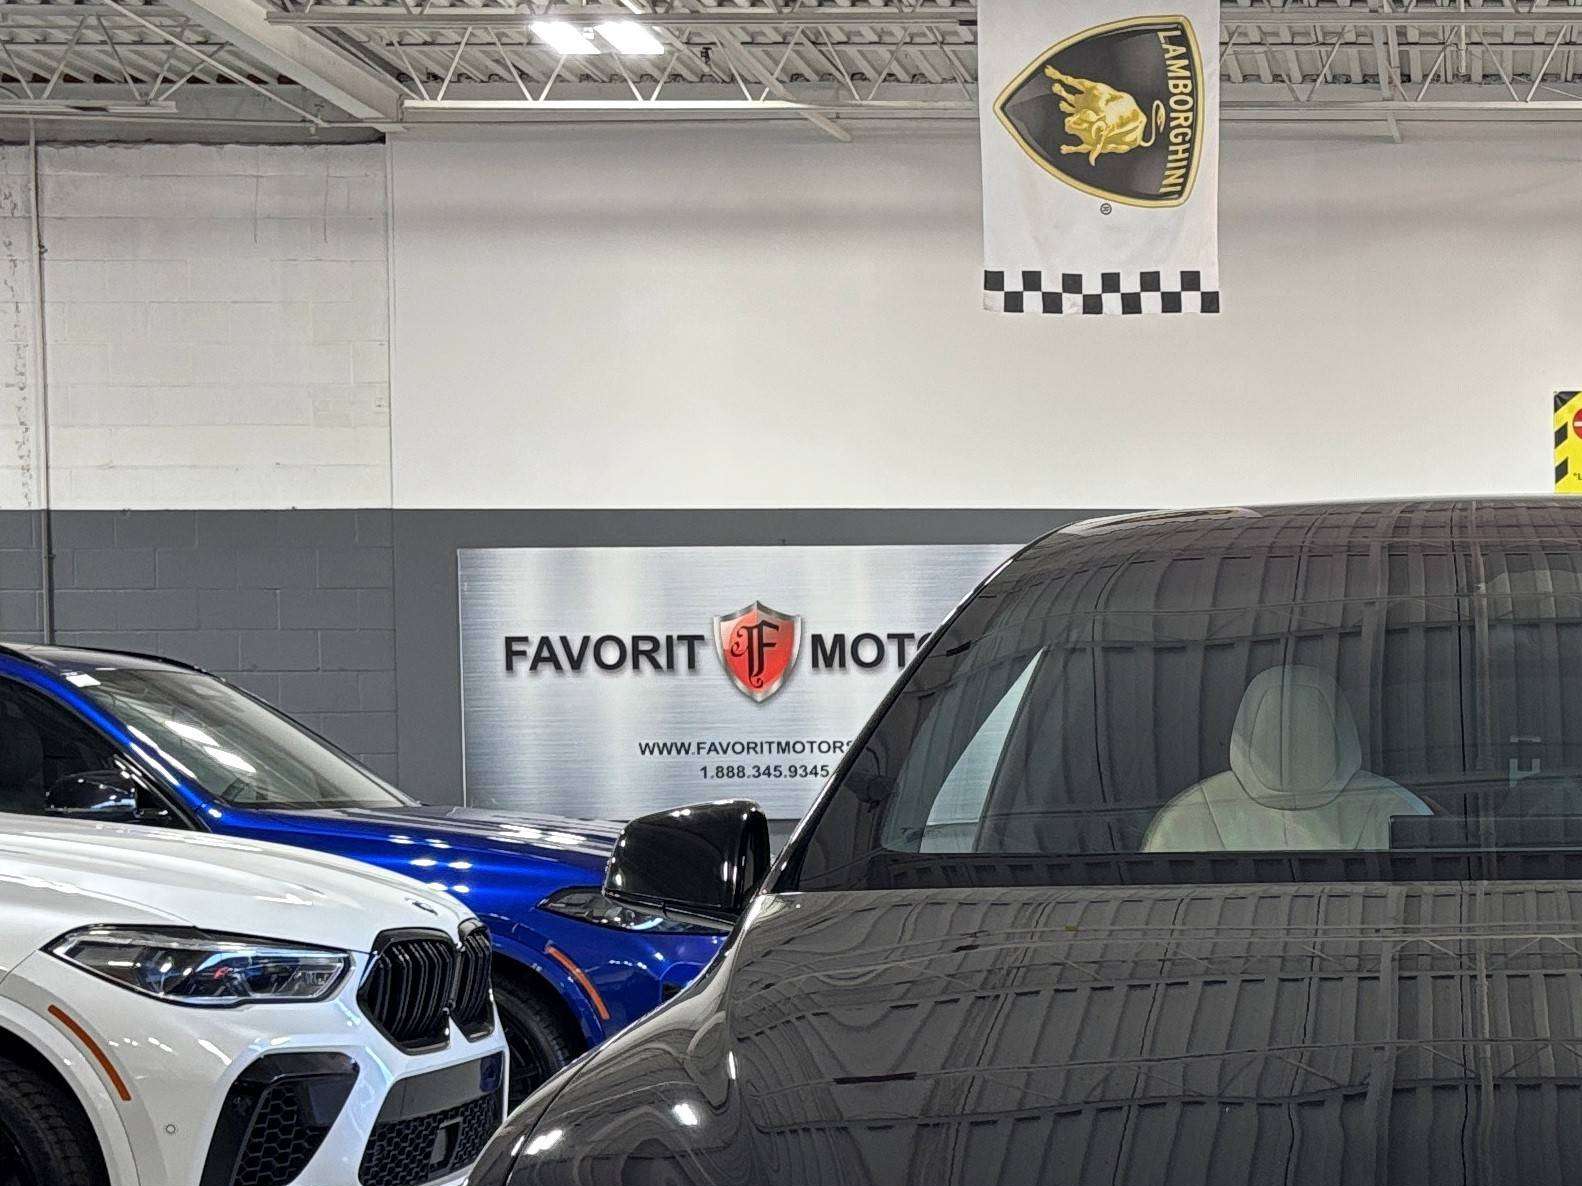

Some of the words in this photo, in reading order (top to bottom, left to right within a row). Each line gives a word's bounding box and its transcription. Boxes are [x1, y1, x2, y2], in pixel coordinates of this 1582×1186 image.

[1156, 29, 1193, 198] LAMBORGHINI
[504, 634, 704, 672] FAVORIT
[811, 632, 933, 668] MOT
[699, 764, 830, 779] 1.888.345.9345
